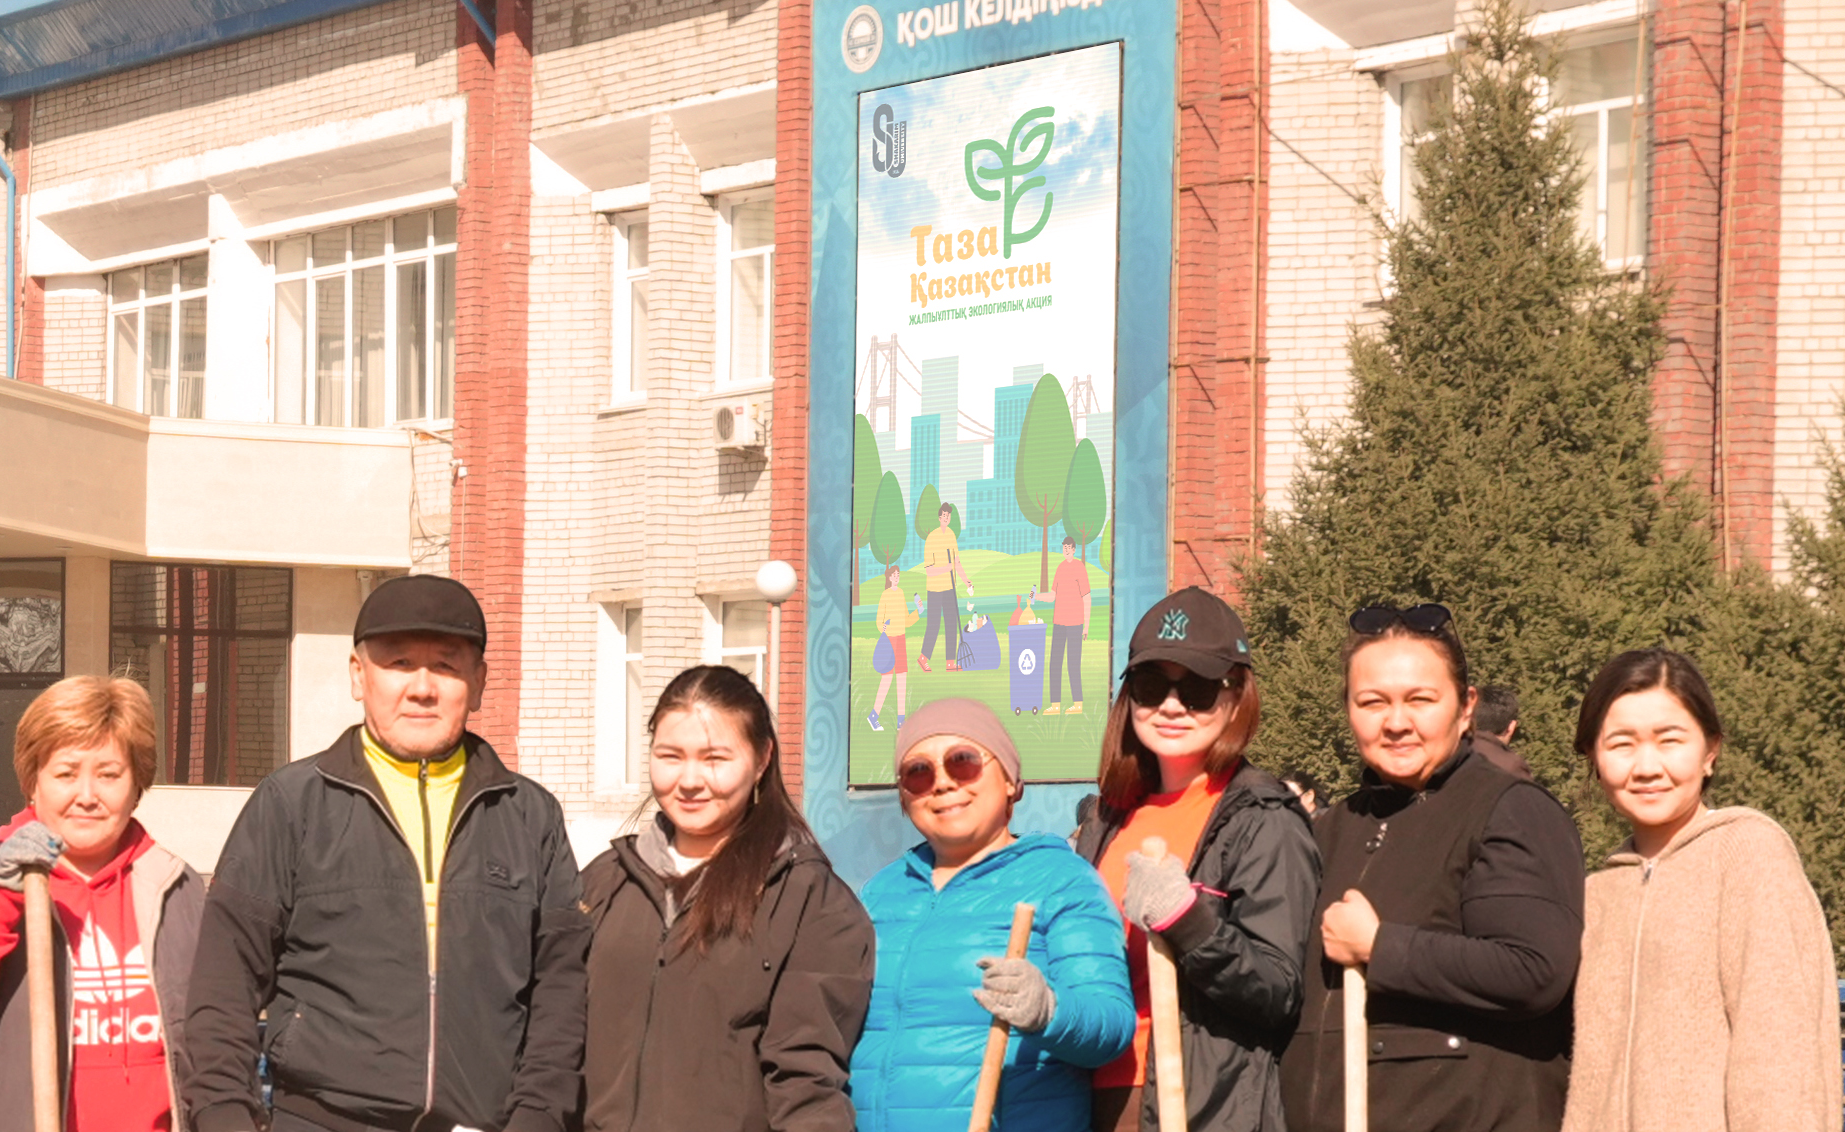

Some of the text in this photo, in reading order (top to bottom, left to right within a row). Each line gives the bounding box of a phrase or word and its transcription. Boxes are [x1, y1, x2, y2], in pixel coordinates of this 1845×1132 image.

[897, 2, 958, 47] ҚОШ
[910, 224, 999, 267] Таза
[910, 262, 1052, 308] Қазақстан
[1026, 294, 1053, 309] АКЦИЯ
[74, 1007, 159, 1045] dida
